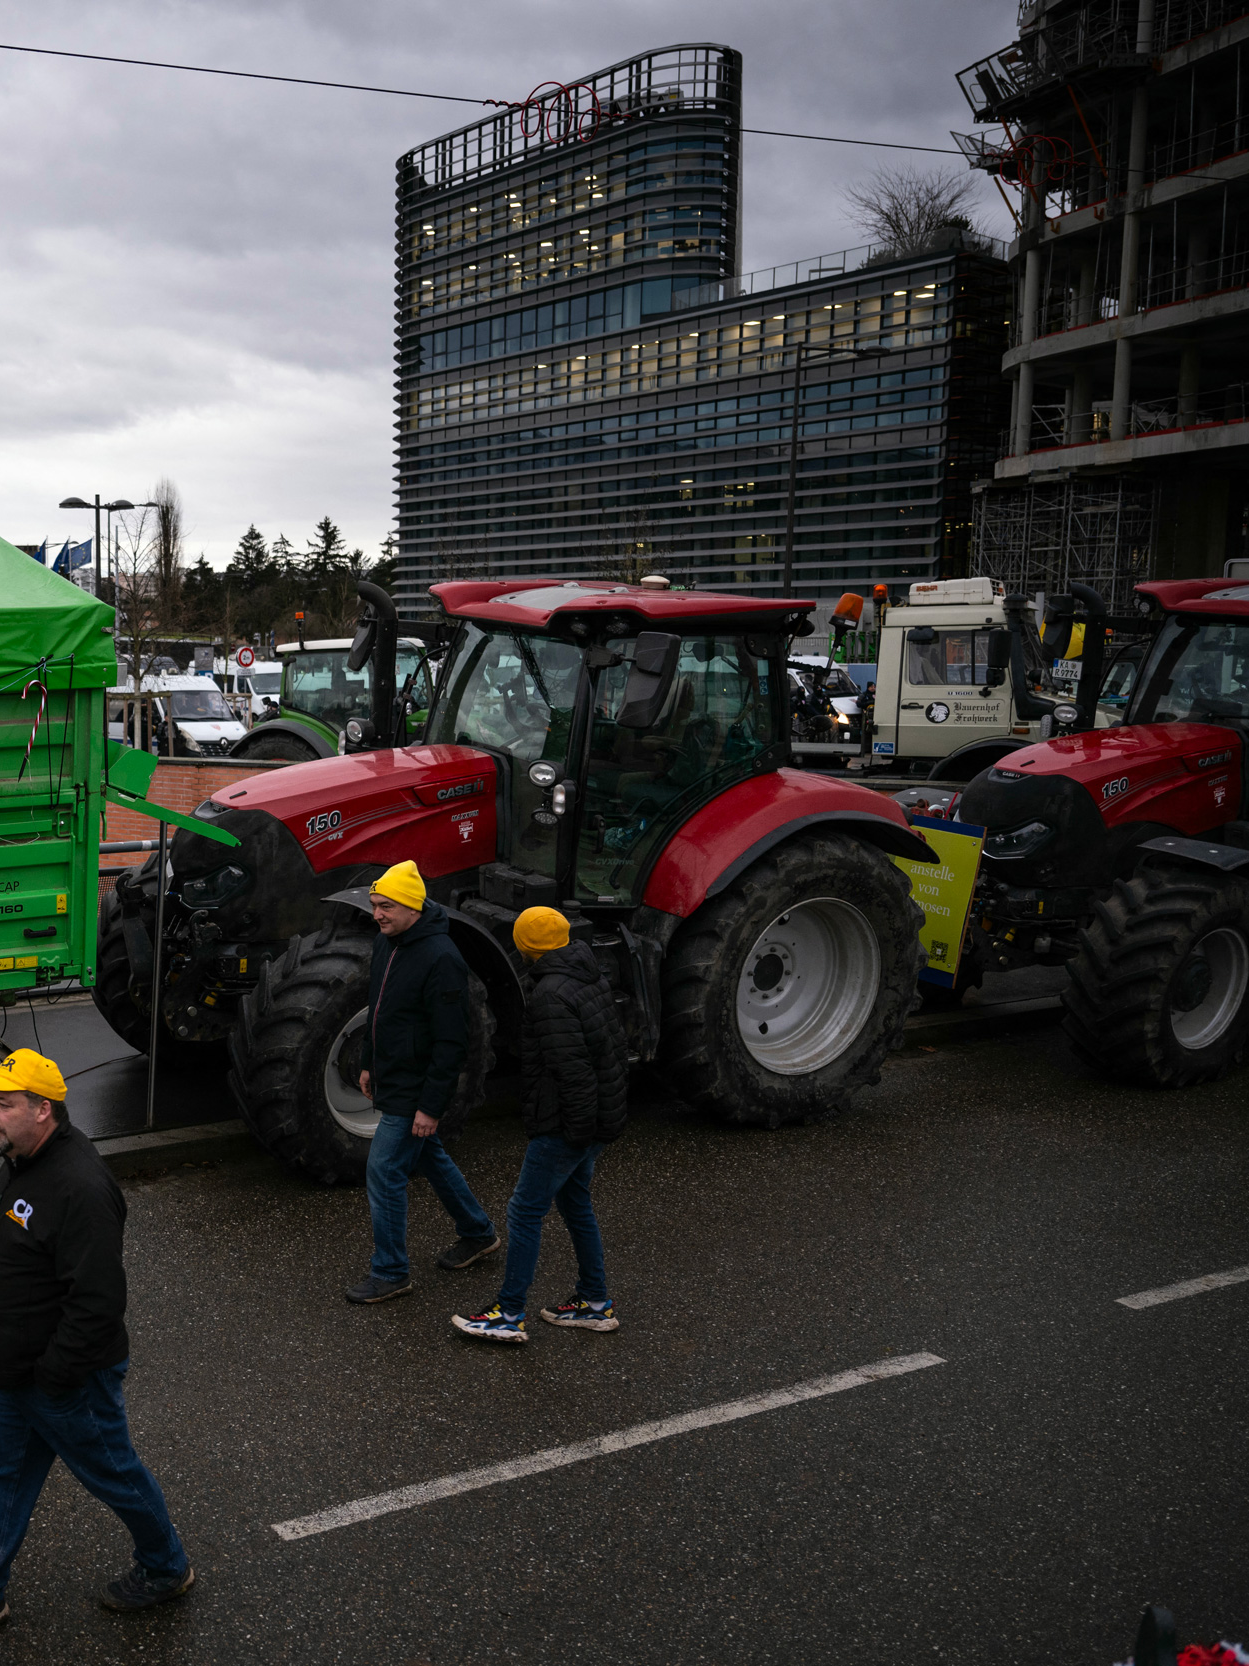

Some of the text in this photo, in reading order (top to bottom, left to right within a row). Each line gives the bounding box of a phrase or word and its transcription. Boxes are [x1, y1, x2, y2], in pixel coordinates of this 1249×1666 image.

[1059, 661, 1069, 669] KA
[953, 701, 1001, 713] Bauernhof
[953, 713, 998, 724] Frohwerk
[1198, 753, 1225, 768] CASE
[437, 783, 473, 800] CASE
[1101, 776, 1130, 799] 150
[306, 810, 342, 836] 150
[910, 865, 956, 882] anstelle
[918, 883, 940, 897] von
